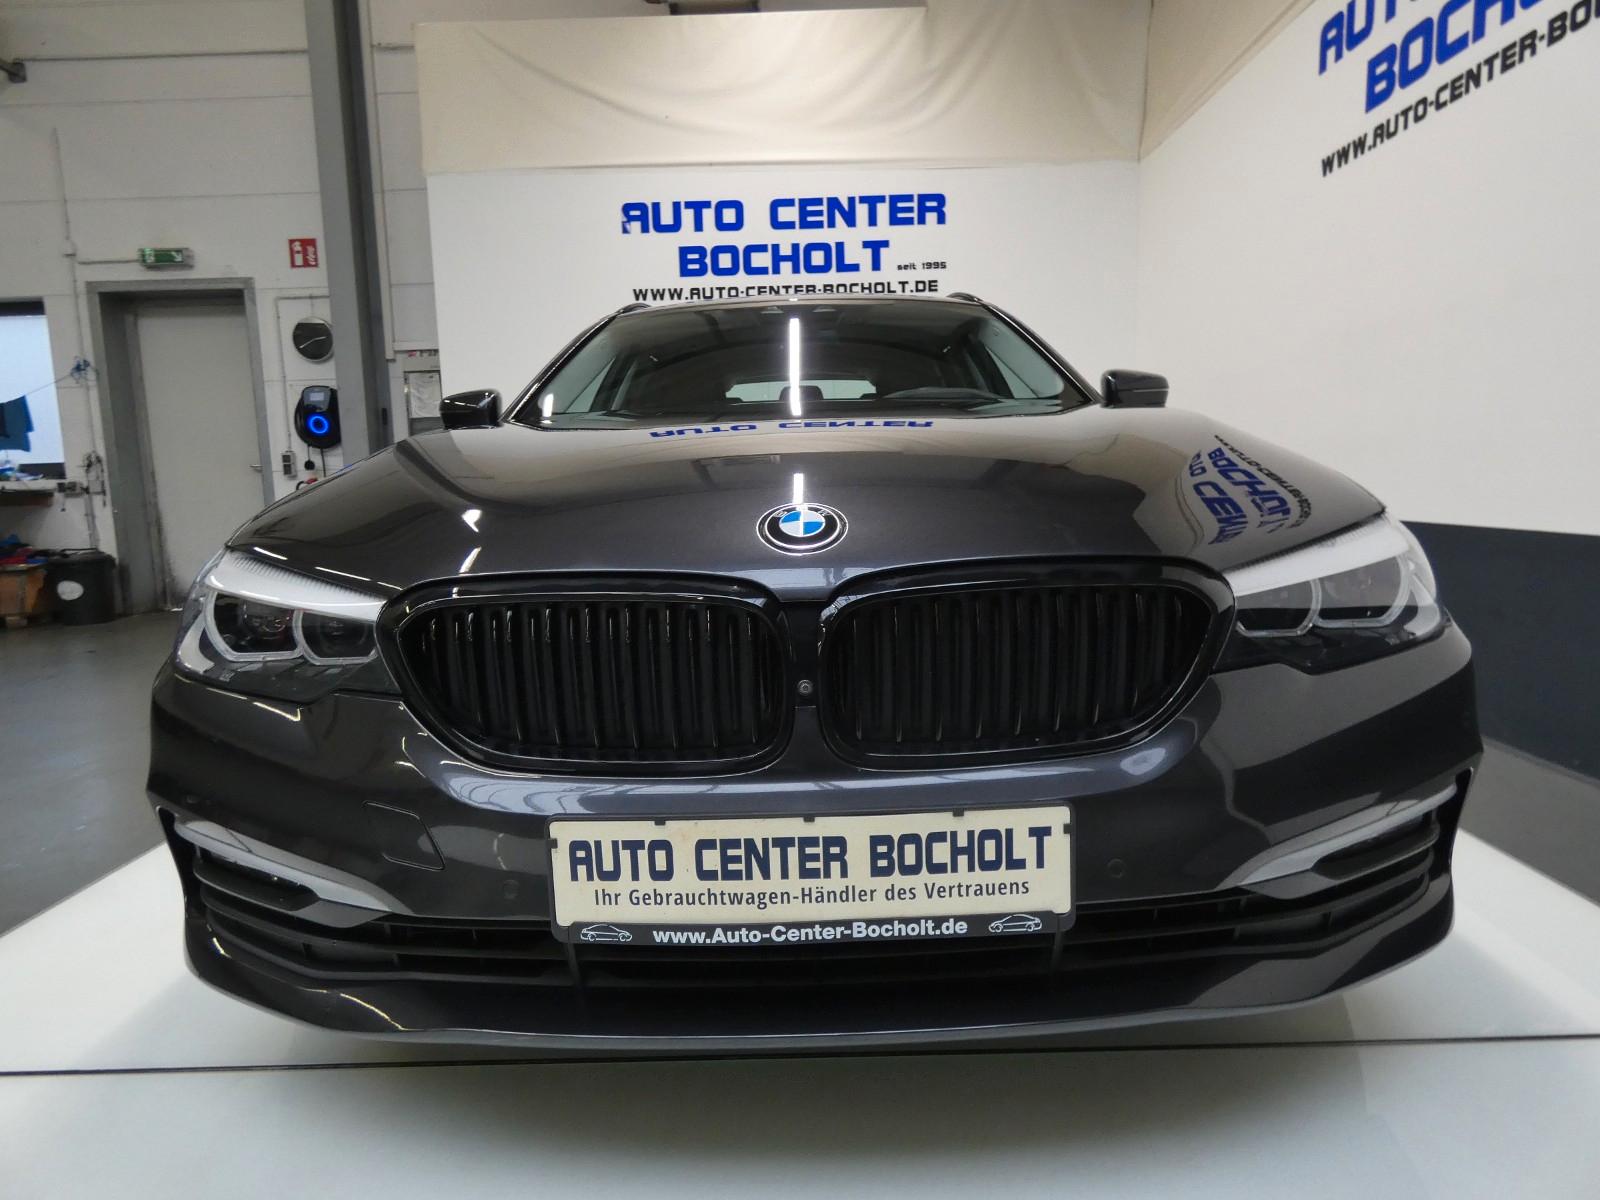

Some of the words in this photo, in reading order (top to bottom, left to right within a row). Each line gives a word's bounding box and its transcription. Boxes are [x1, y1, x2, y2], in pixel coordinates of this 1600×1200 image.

[1365, 0, 1543, 114] BOCH
[621, 200, 744, 234] AUTO
[769, 193, 946, 230] CENTER
[678, 239, 889, 278] BOCHOLT
[897, 263, 917, 271] seit
[922, 261, 947, 270] 1995
[633, 280, 938, 300] WWW.AUTO-CENTER-BOCHOLT.DE
[569, 839, 674, 881] AUTO
[695, 836, 848, 881] CENTER
[869, 826, 1052, 878] BOCHOLT
[594, 888, 622, 907] Ihr
[628, 884, 878, 910] Gebrauchtwagen-Händler
[884, 883, 918, 901] des
[924, 878, 1031, 898] Vertrauens
[653, 919, 968, 944] www.Auto-Center-Bocholt.de
